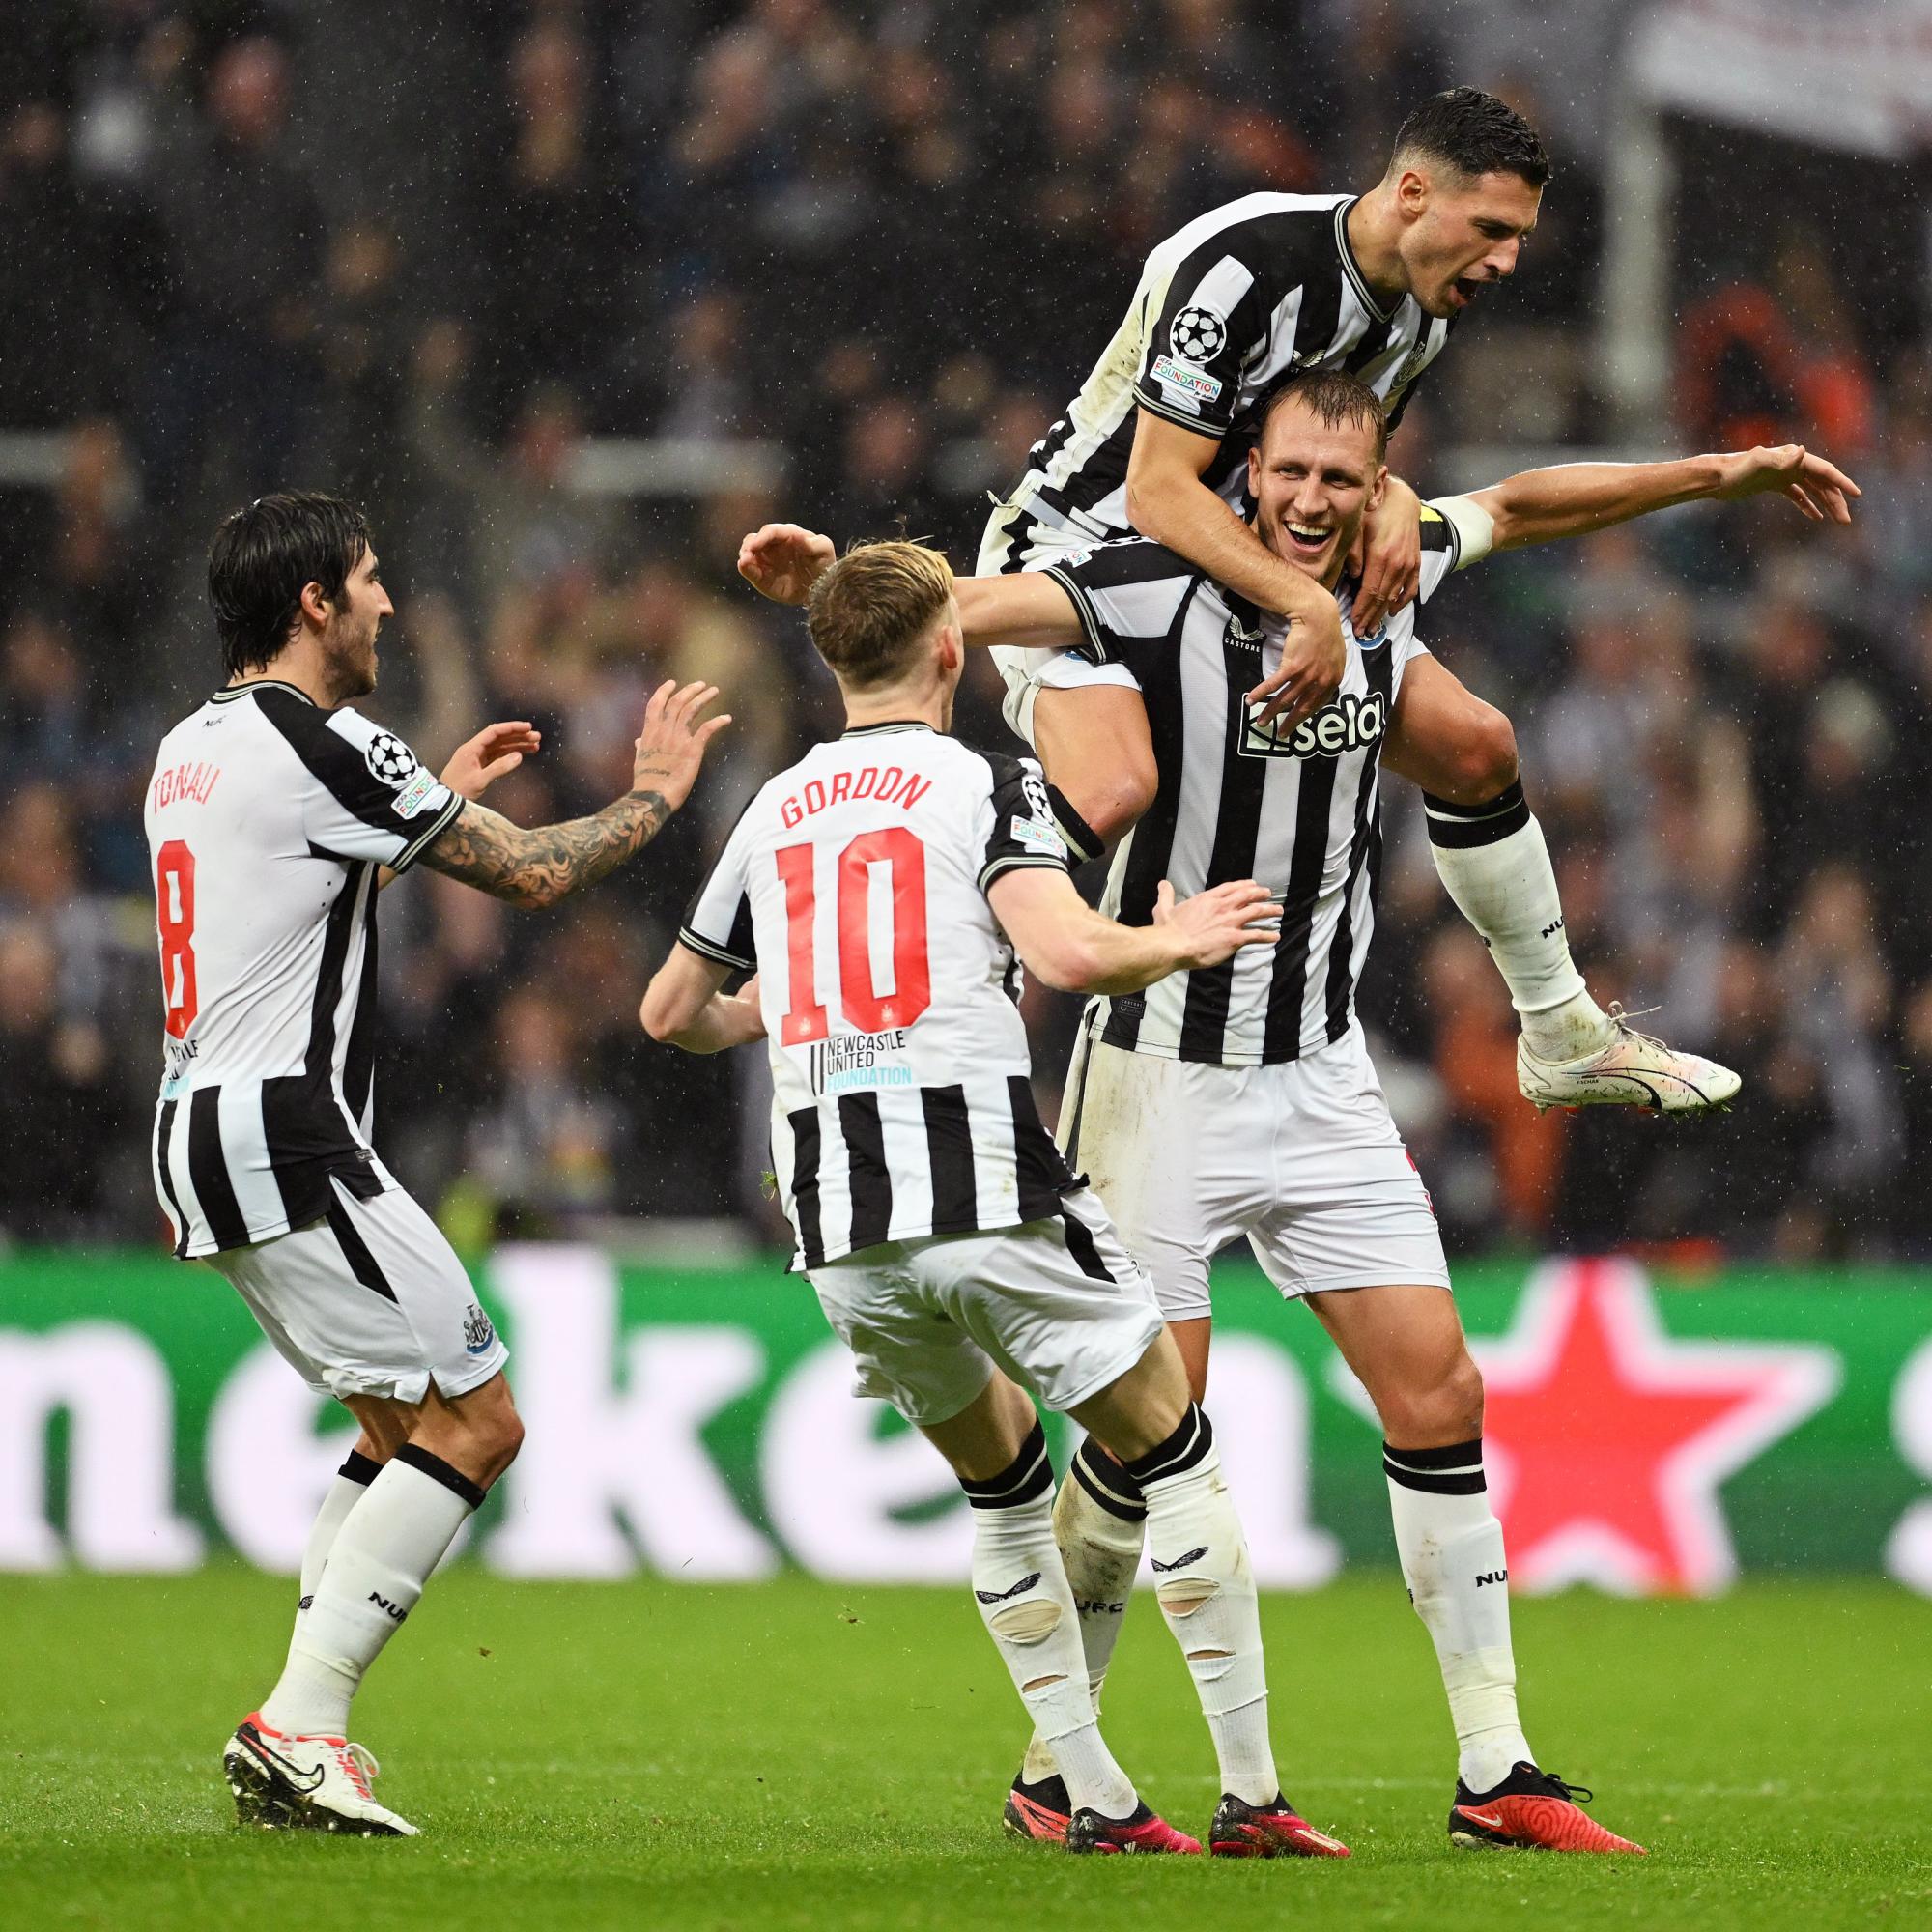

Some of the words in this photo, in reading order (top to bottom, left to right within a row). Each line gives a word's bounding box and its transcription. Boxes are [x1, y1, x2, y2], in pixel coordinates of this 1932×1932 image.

[1154, 362, 1219, 395] FOUNDATION
[1224, 637, 1261, 653] CASTORE
[154, 762, 221, 815] TONALI
[781, 766, 932, 829] GORDON
[157, 839, 198, 1040] 8
[775, 826, 930, 1048] 10
[826, 1030, 906, 1058] NEWCASTLE
[826, 1051, 875, 1075] UNITED
[826, 1065, 913, 1092] FOUNDATION
[1073, 1598, 1123, 1614] UFC
